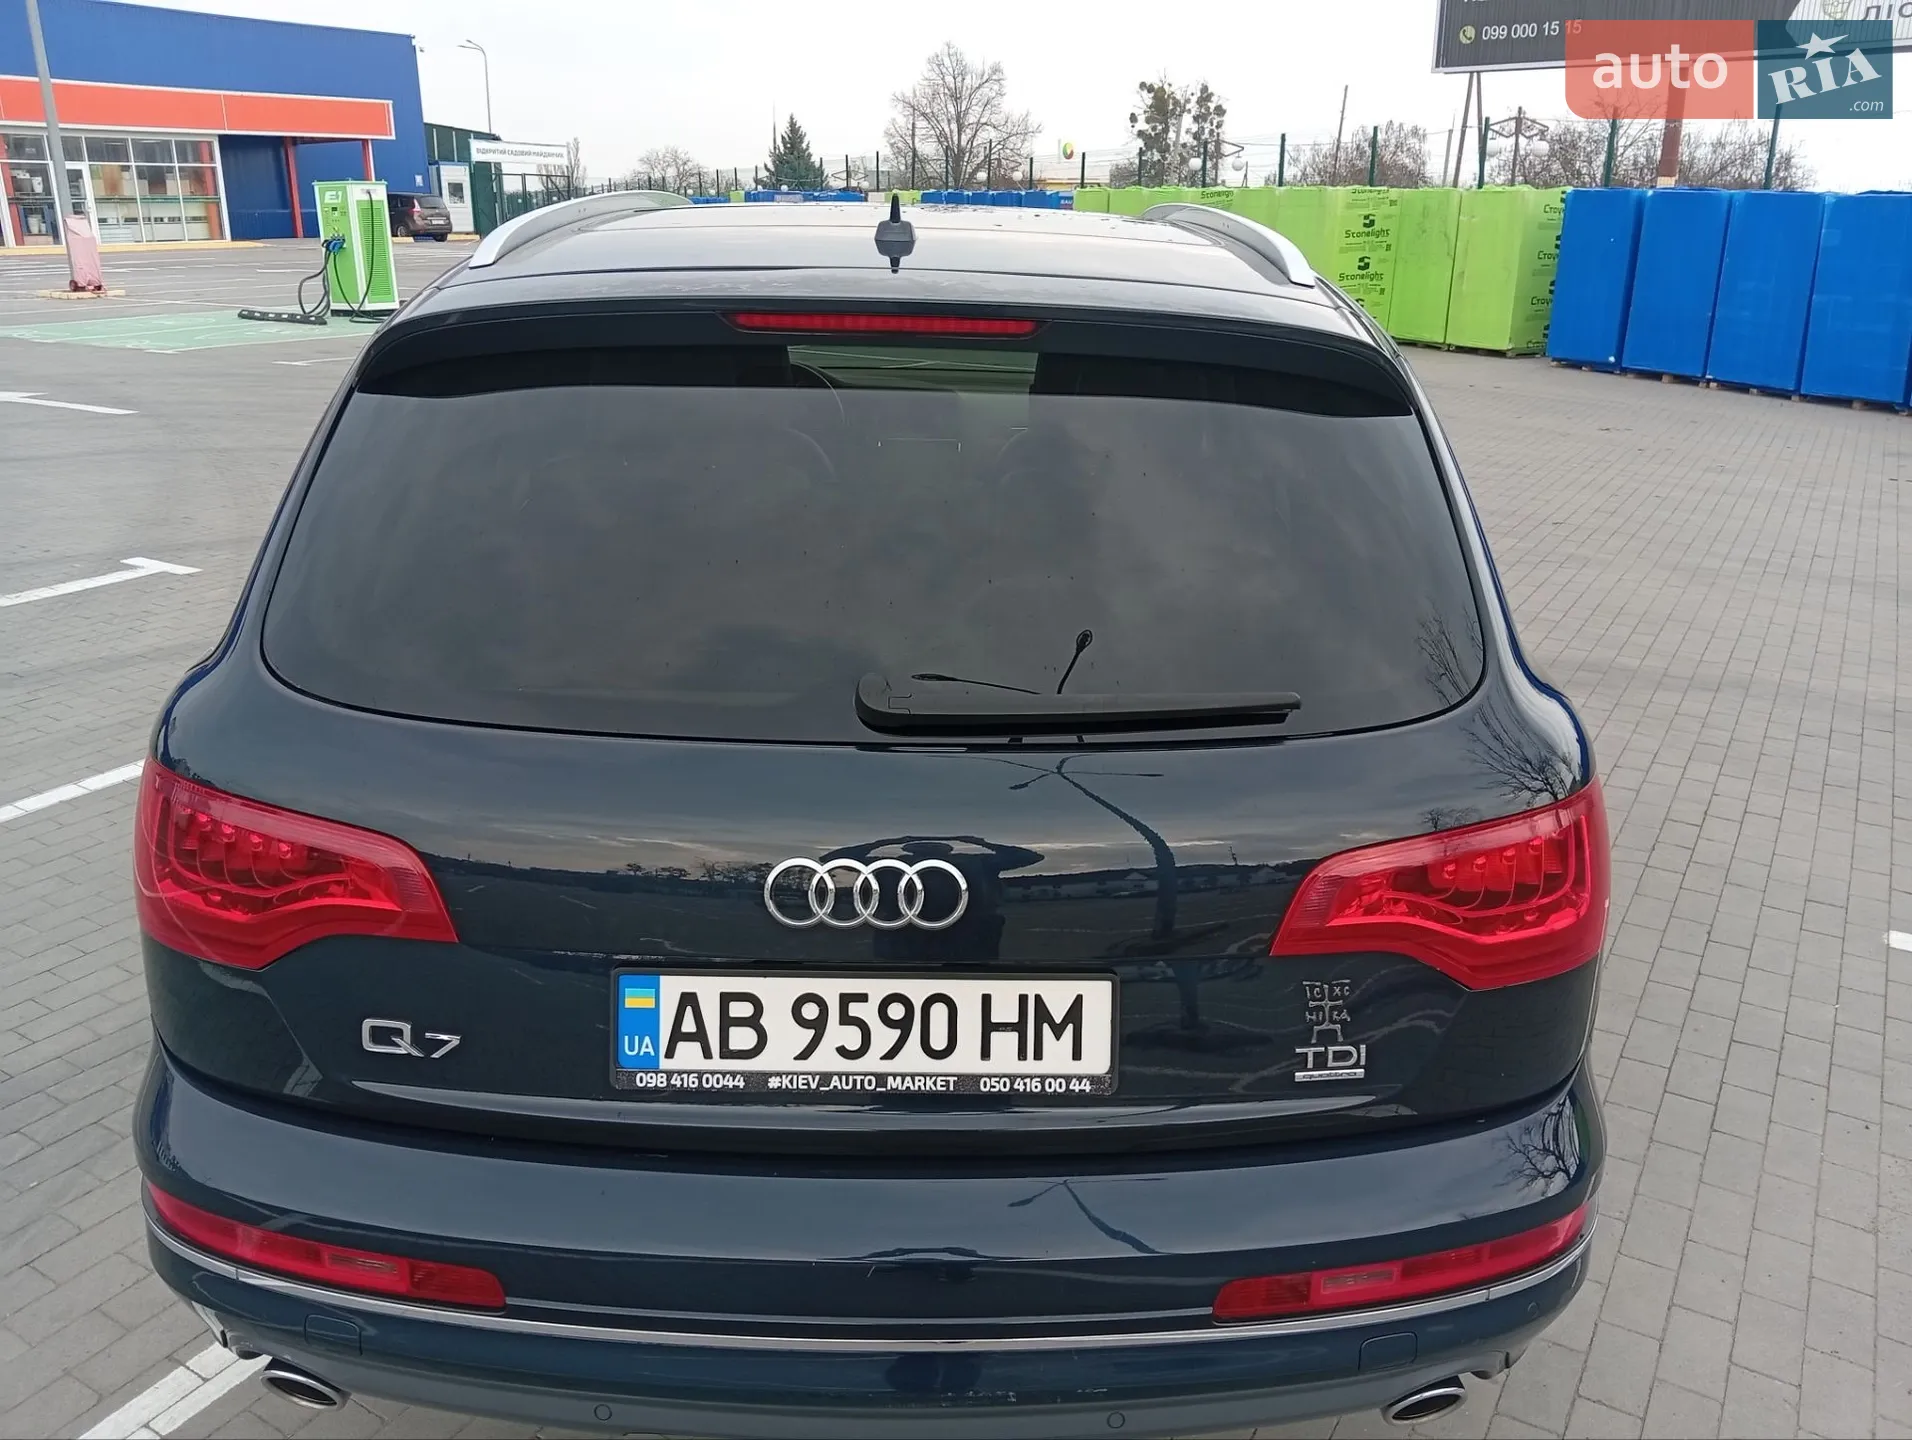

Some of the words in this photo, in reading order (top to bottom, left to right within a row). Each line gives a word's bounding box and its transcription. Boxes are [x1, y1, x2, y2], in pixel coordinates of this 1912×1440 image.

[1482, 25, 1508, 40] 099
[1511, 23, 1538, 39] 000
[1542, 21, 1560, 36] 15
[1566, 19, 1583, 34] 15
[1344, 228, 1391, 239] Stonelight
[1338, 271, 1385, 281] Stonelight
[664, 991, 769, 1060] AB
[791, 992, 959, 1061] 9590
[980, 993, 1084, 1061] HM
[361, 1018, 462, 1059] Q7
[624, 1035, 655, 1056] UA
[1295, 1044, 1367, 1069] TDI
[635, 1072, 667, 1087] 098
[670, 1073, 699, 1088] 416
[702, 1074, 745, 1088] 0044
[768, 1075, 958, 1091] #KIEV_AUTO_MARKET
[979, 1077, 1010, 1092] 050
[1013, 1077, 1041, 1092] 416
[1044, 1078, 1066, 1092] 00
[1069, 1078, 1091, 1093] 44
